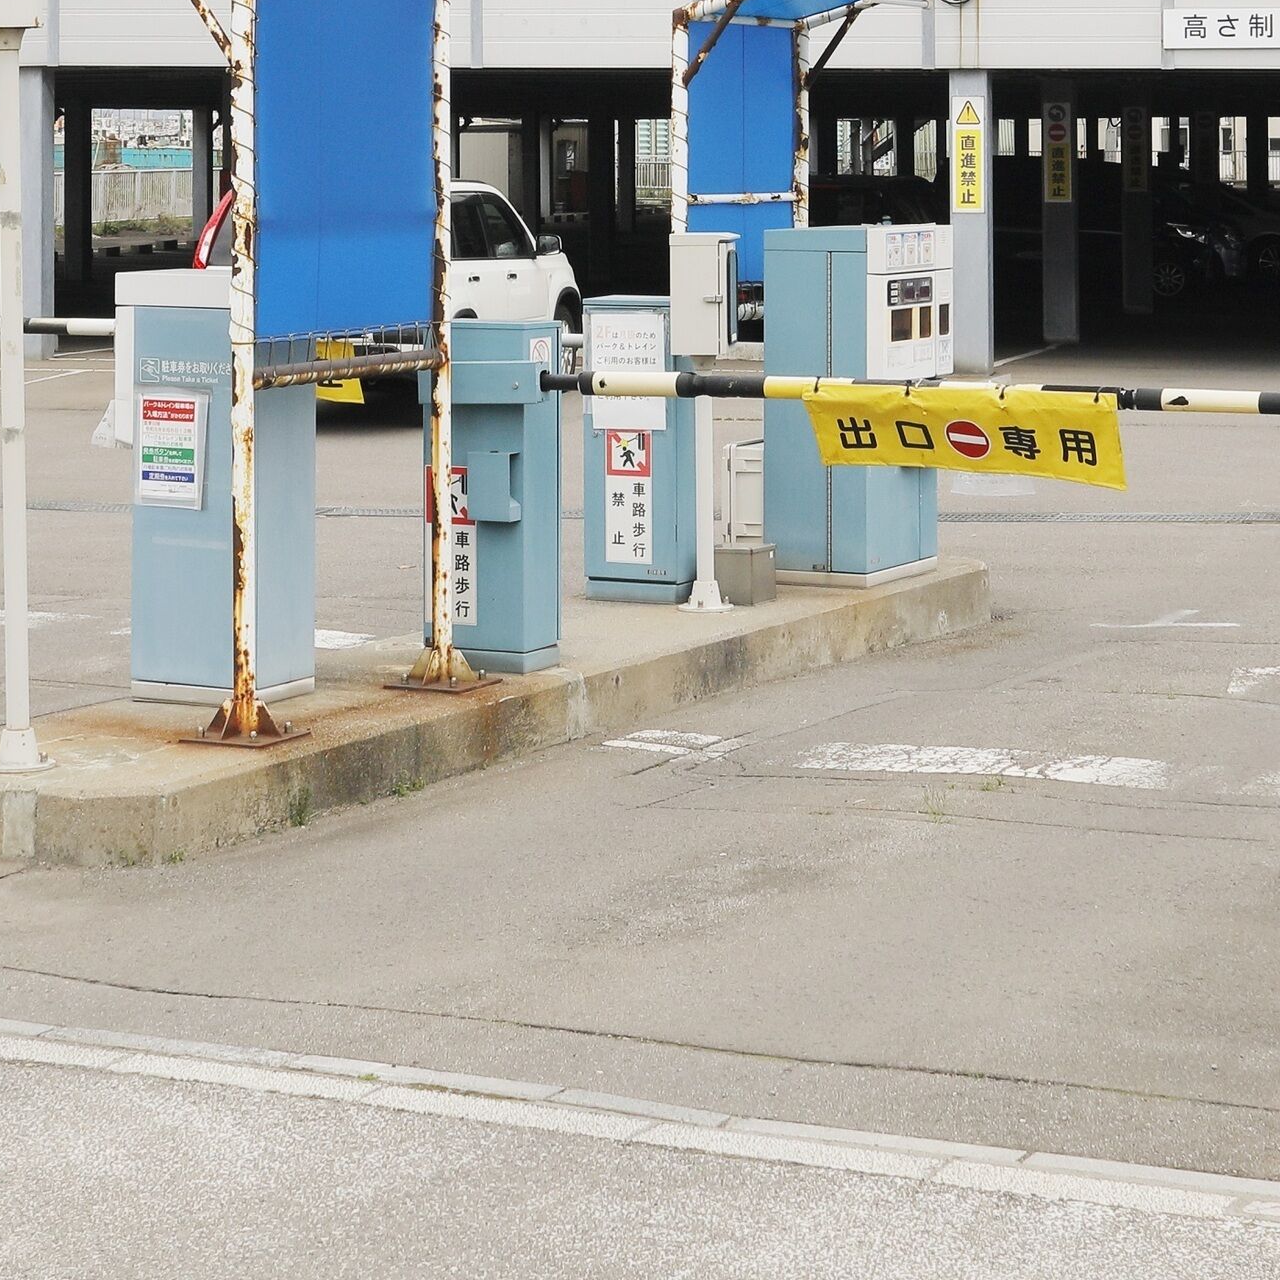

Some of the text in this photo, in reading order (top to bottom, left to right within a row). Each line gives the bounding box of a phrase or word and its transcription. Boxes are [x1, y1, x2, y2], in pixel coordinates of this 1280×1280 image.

[959, 134, 977, 205] 直進禁止
[1050, 146, 1067, 199] 直進禁止
[836, 416, 1098, 467] 出口 専用
[611, 491, 626, 545] 禁止
[631, 482, 646, 558] 車路歩行
[454, 530, 471, 618] 車路歩行
